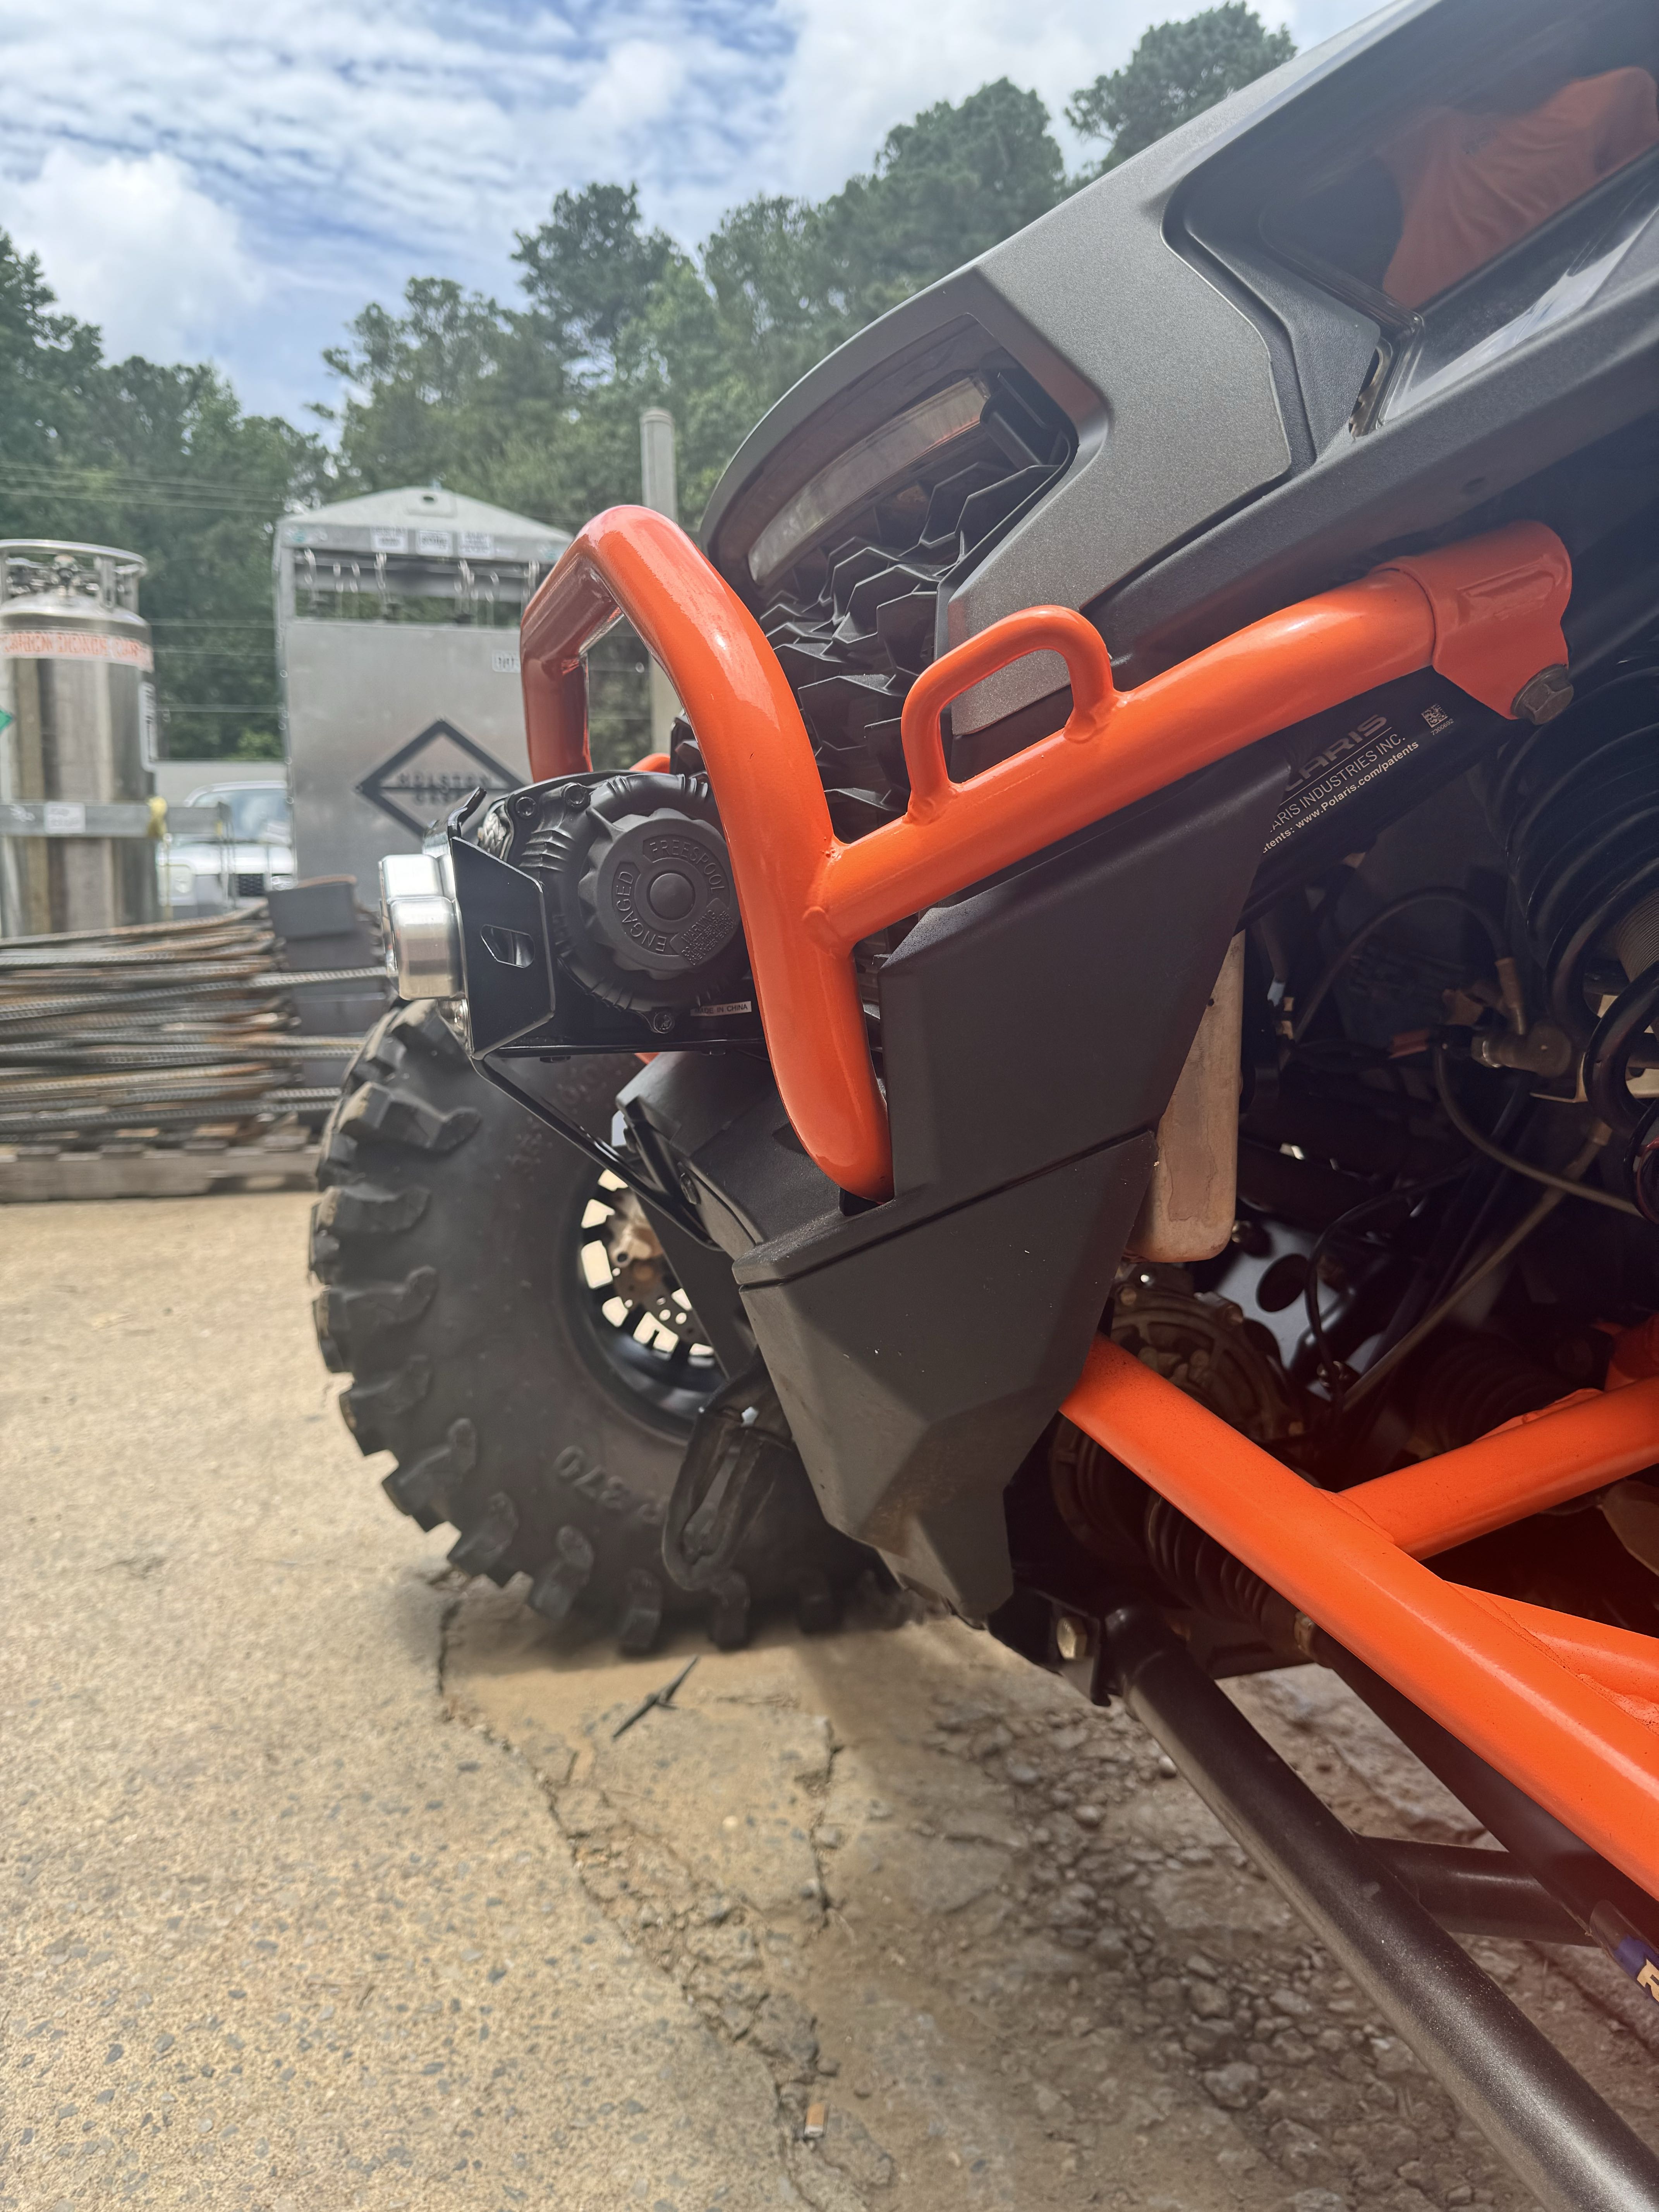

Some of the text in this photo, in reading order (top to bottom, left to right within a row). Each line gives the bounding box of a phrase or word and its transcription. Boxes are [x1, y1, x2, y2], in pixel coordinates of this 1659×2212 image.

[1270, 734, 1405, 833] ARIS INDUSTRIES INC.
[1286, 714, 1387, 792] LARIS
[1295, 740, 1419, 829] www.Polaris.com/patents
[649, 839, 725, 894] FREESPOOL
[615, 871, 667, 952] ENGAGED
[680, 908, 718, 945] WARNING
[727, 1004, 748, 1012] CHINA
